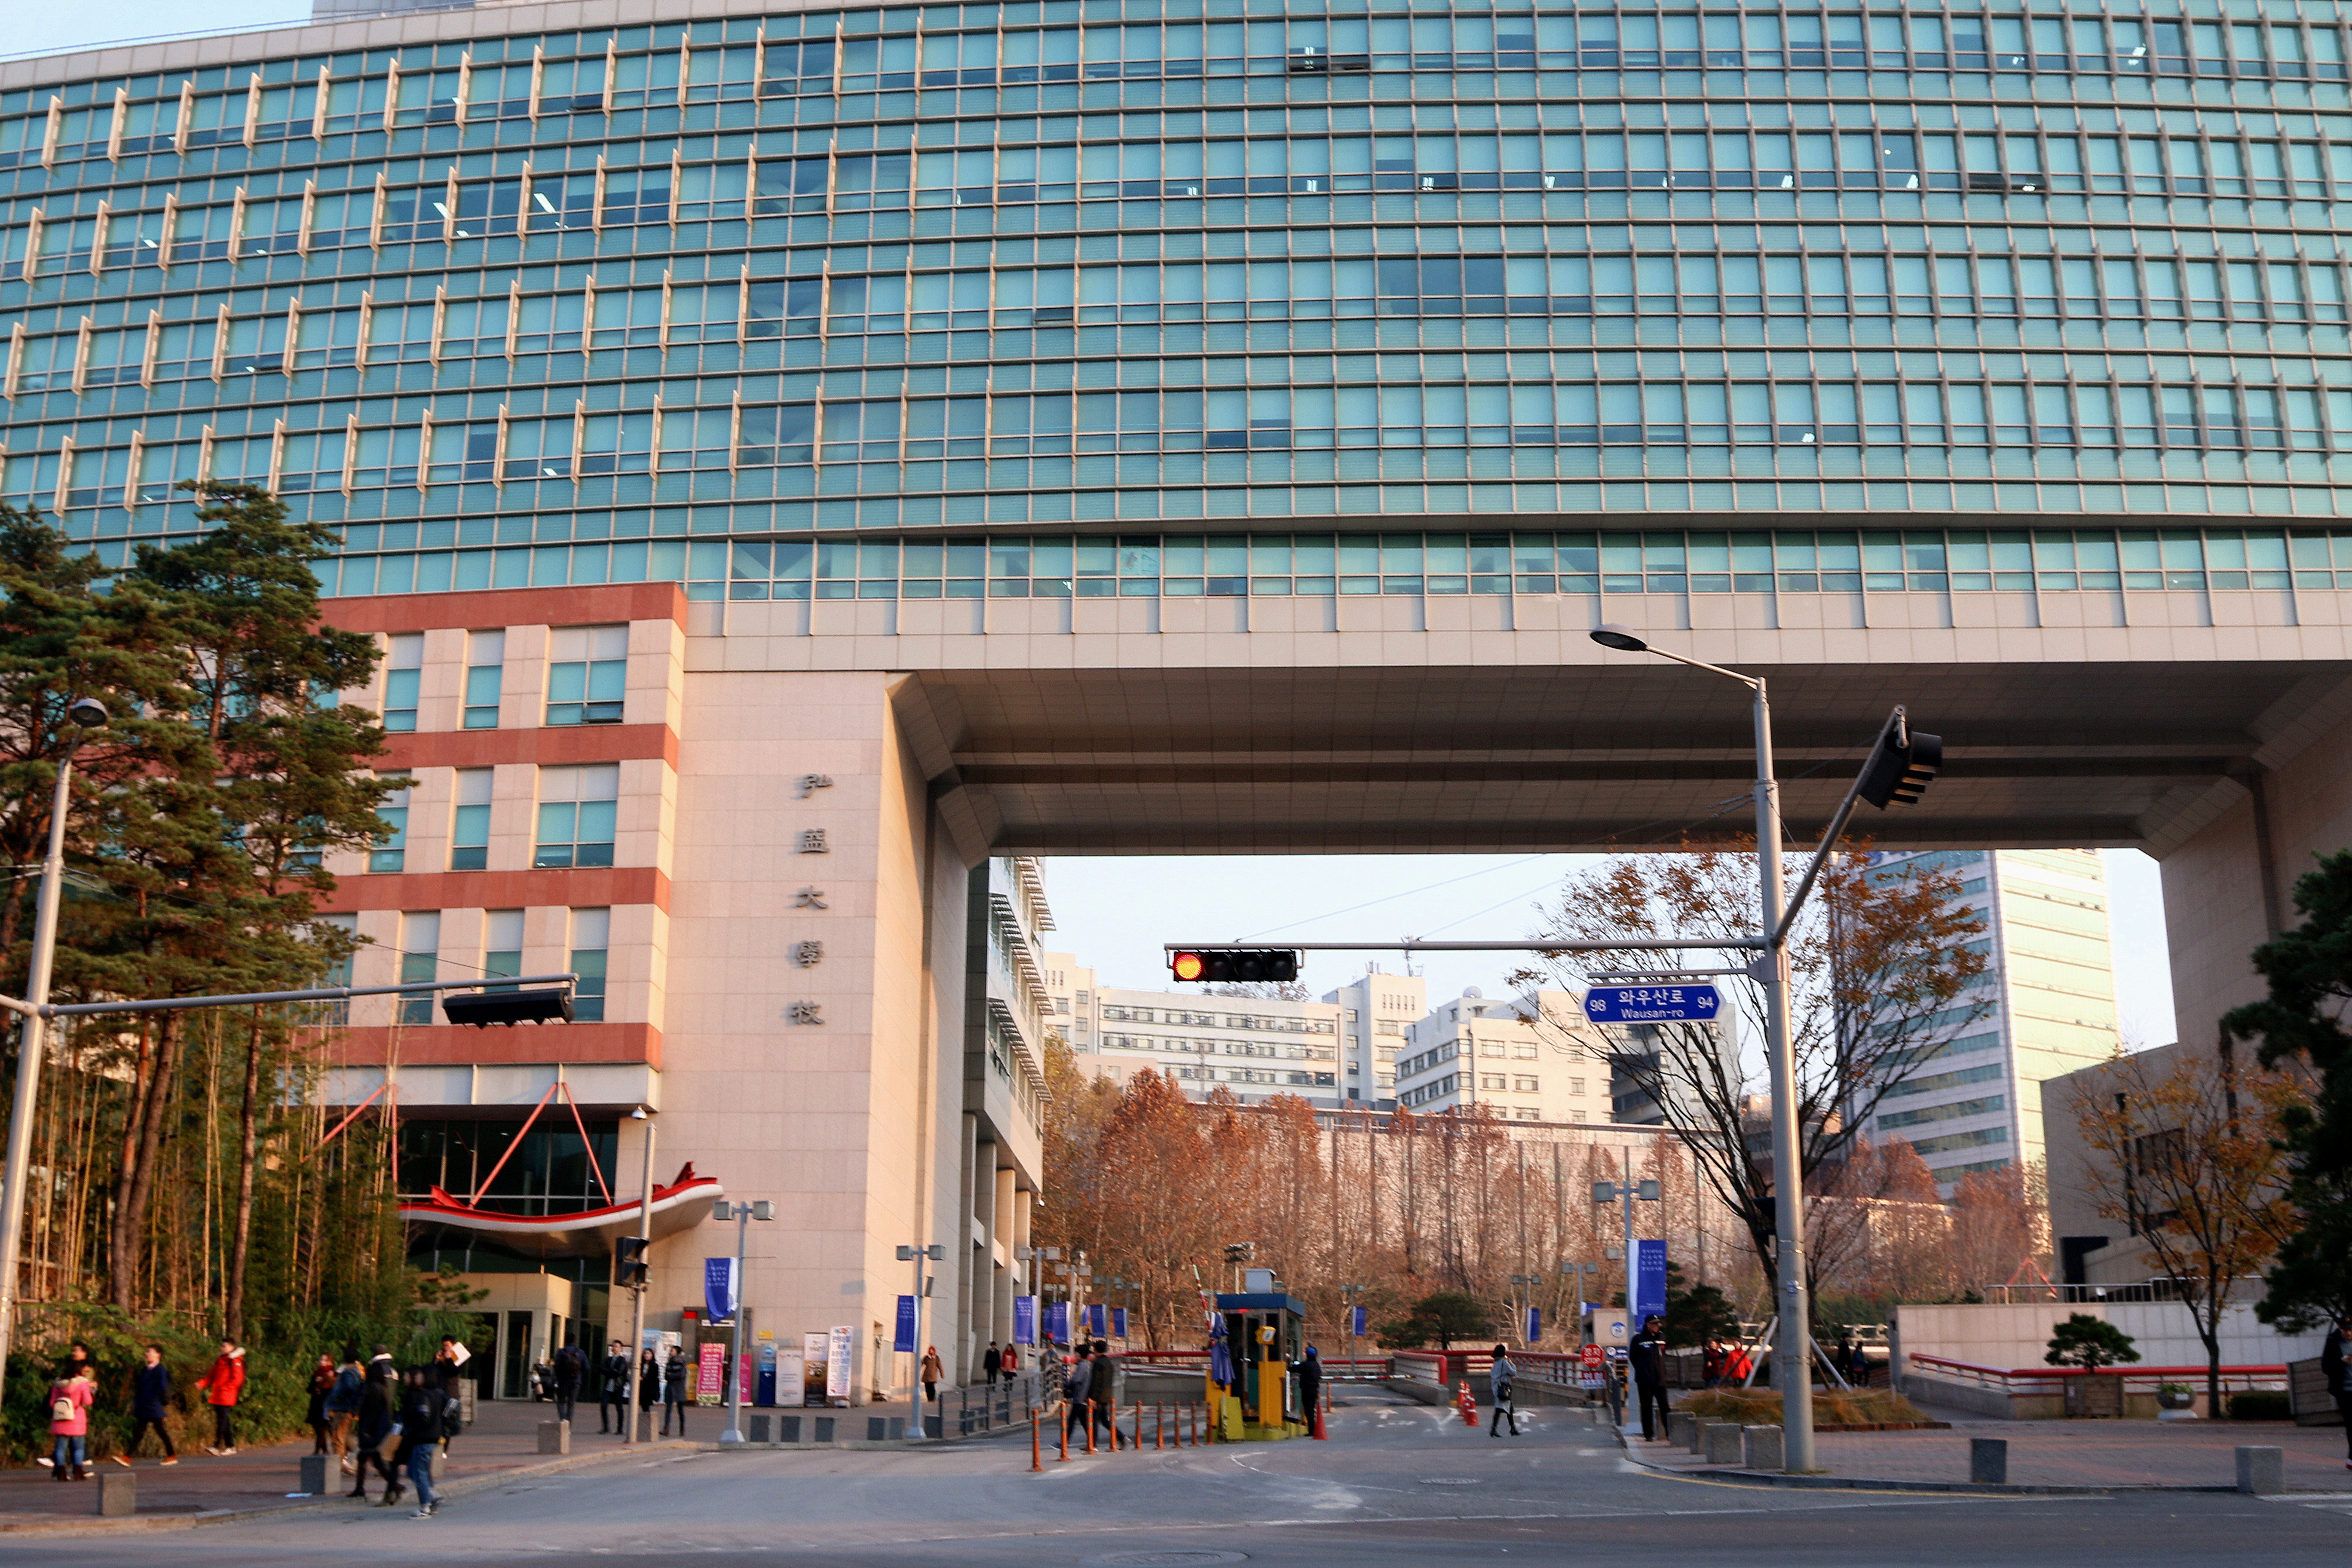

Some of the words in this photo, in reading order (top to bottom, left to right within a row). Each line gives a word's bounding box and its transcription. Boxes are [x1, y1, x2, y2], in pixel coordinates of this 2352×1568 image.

[1619, 989, 1686, 1006] 와우산로
[1697, 996, 1714, 1009] 94
[1589, 999, 1607, 1012] 98
[1621, 1008, 1685, 1019] Wausan-ro
